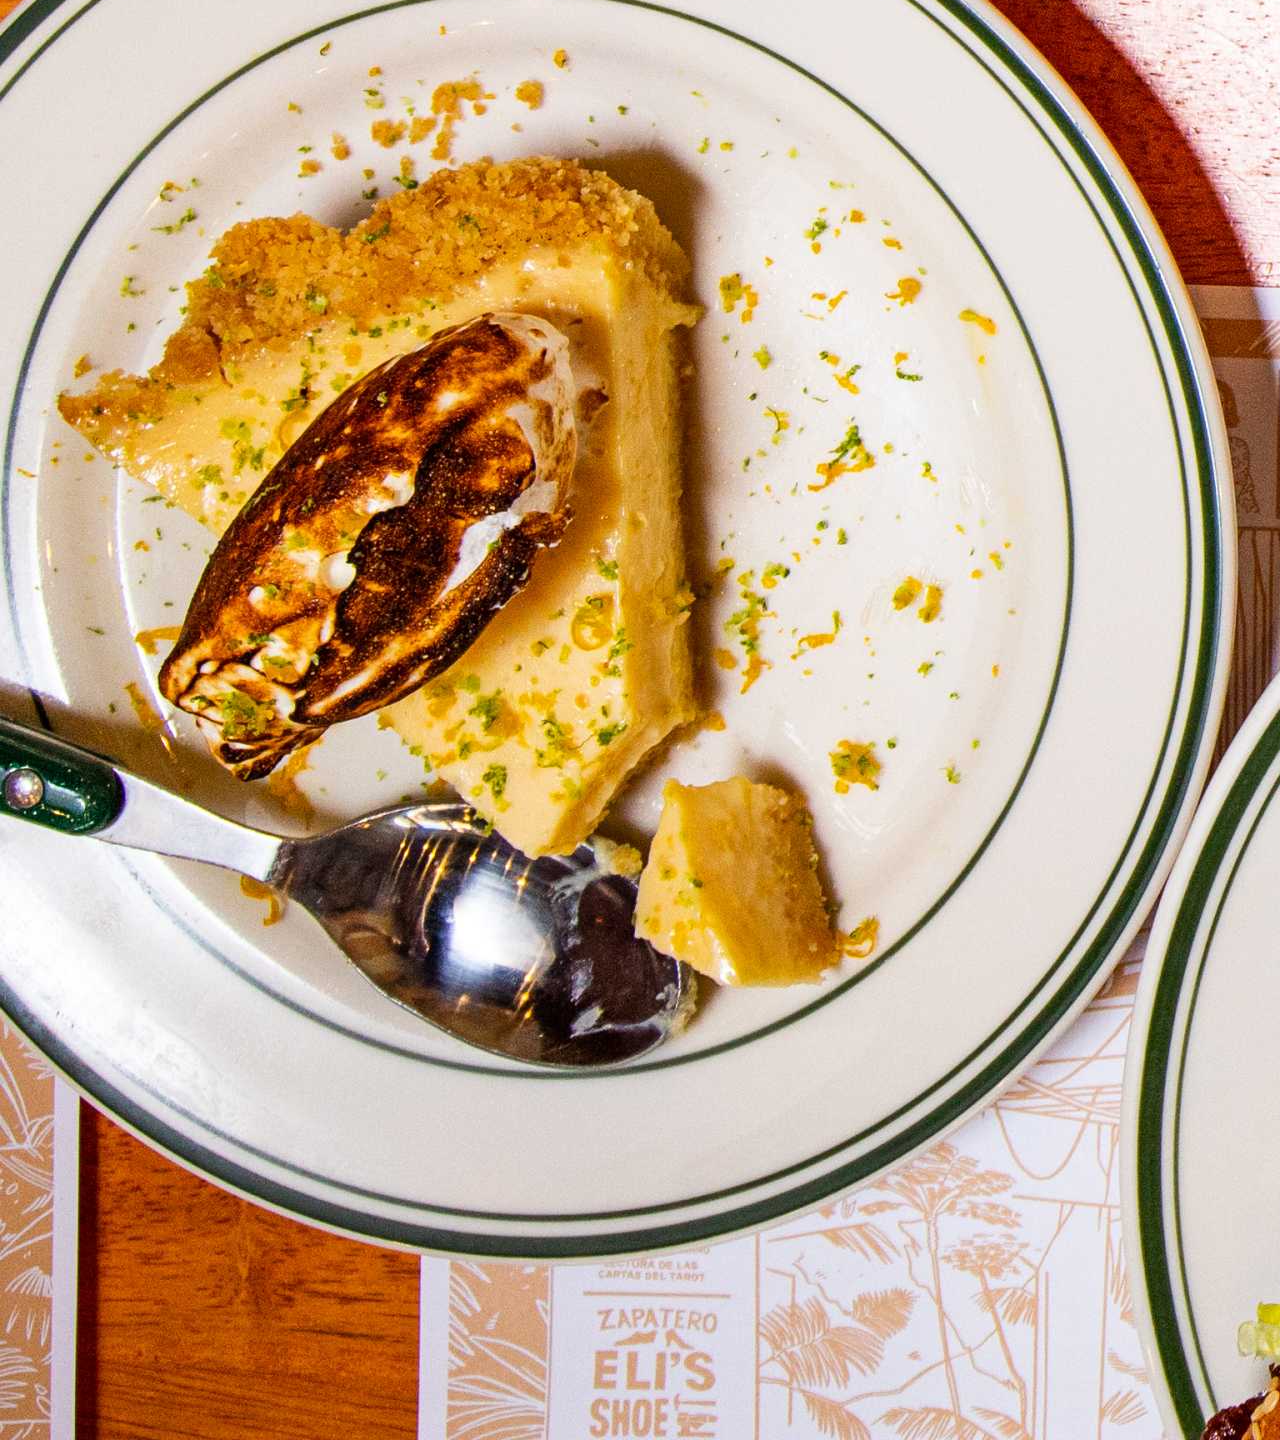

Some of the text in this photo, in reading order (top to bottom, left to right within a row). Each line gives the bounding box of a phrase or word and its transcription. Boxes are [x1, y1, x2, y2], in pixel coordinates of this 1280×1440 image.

[598, 1269, 641, 1281] CARTAS
[671, 1272, 705, 1282] TAROT
[597, 1307, 718, 1335] ZAPATERO
[592, 1349, 717, 1392] ELI'S
[589, 1397, 669, 1439] SHOE
